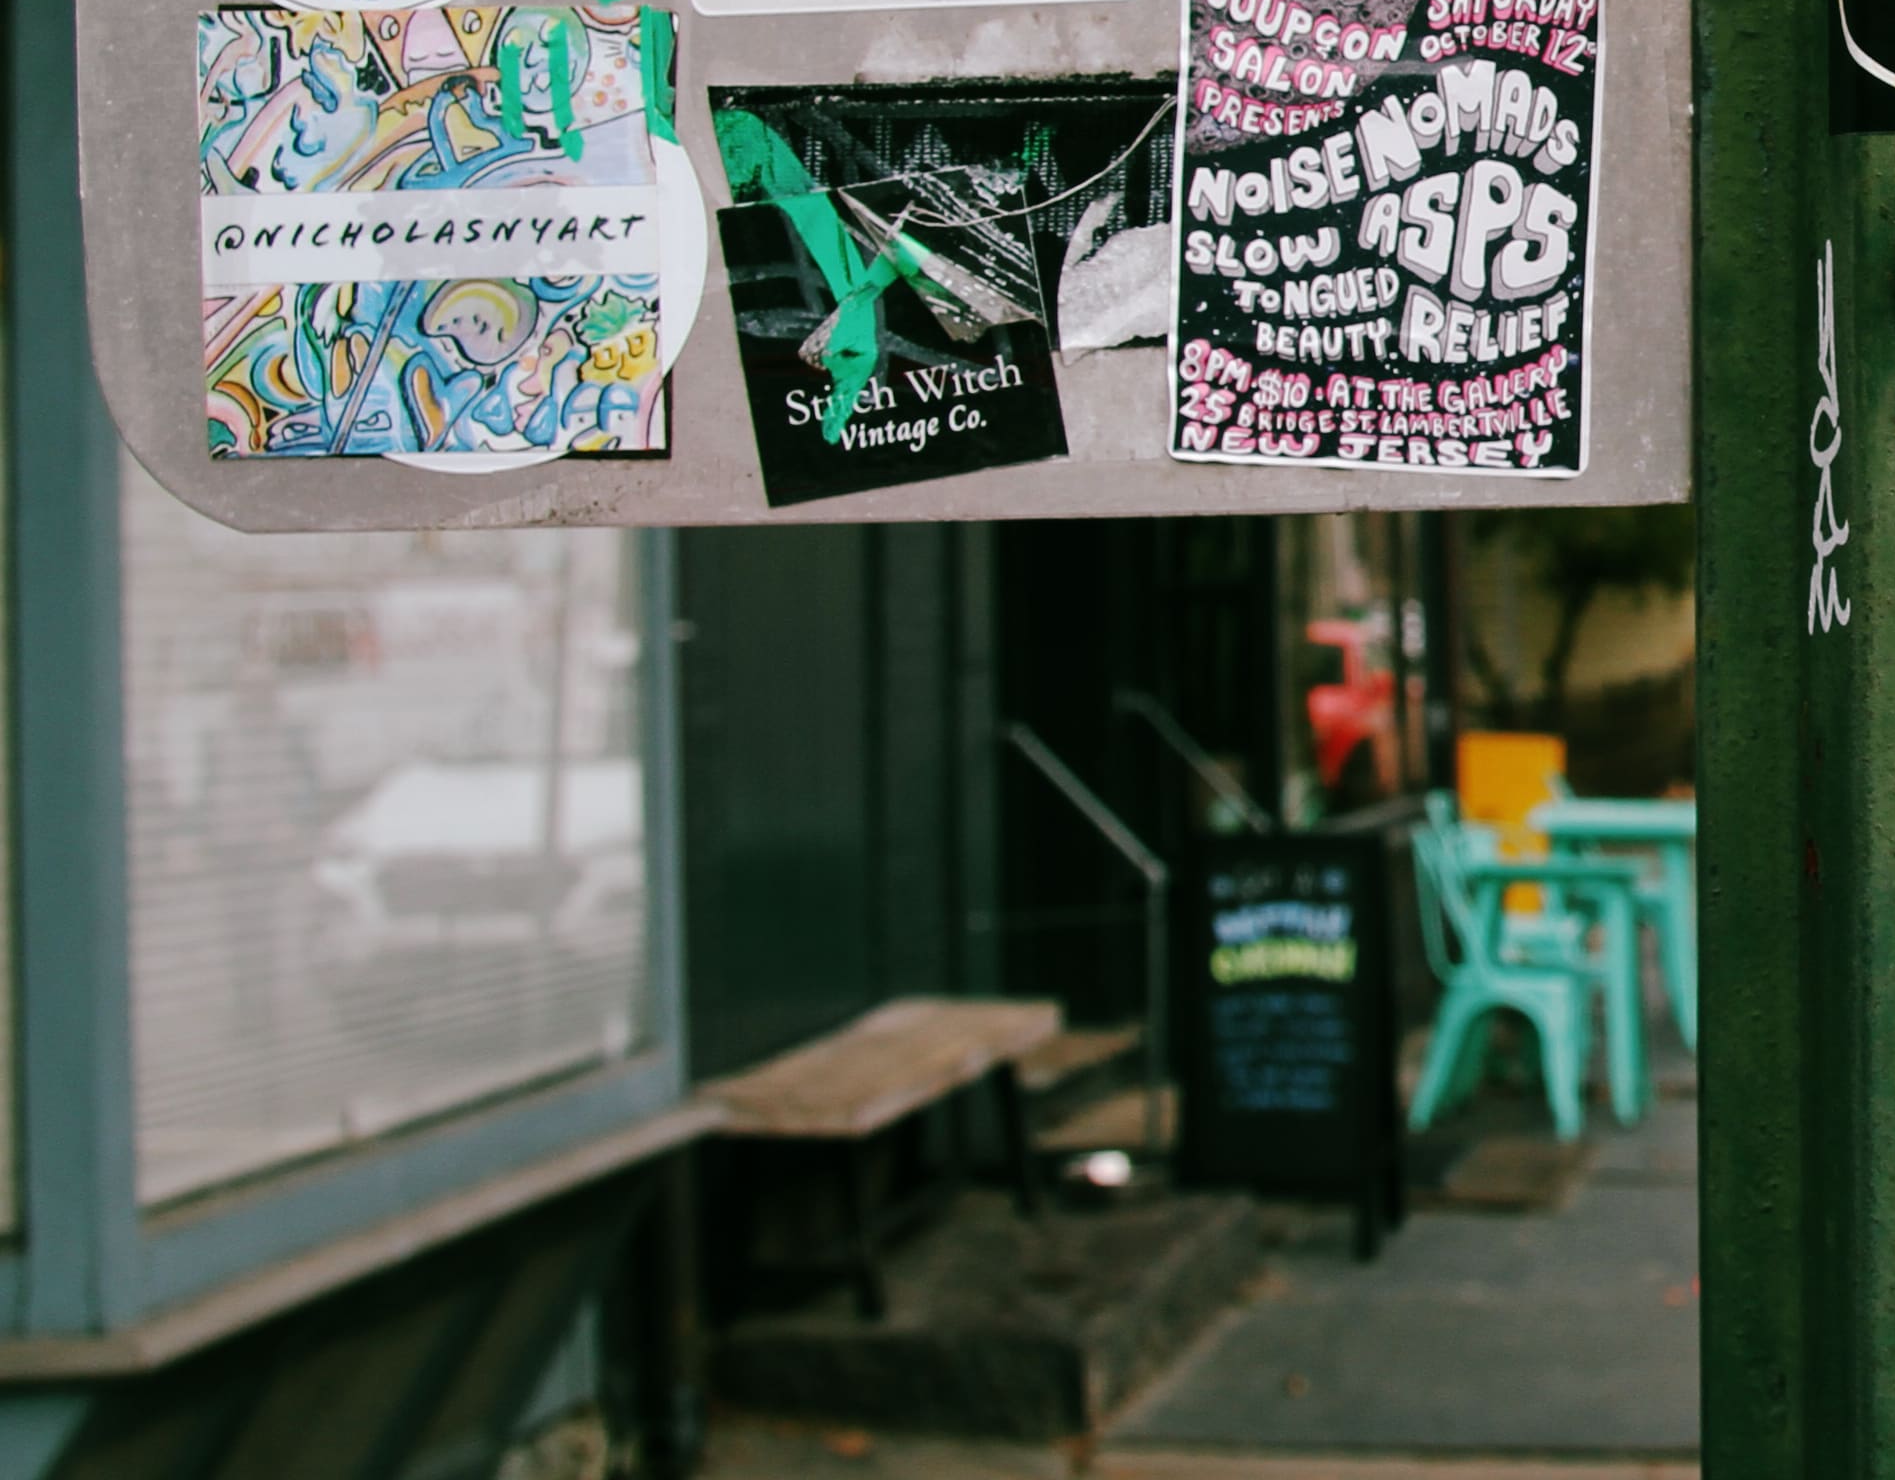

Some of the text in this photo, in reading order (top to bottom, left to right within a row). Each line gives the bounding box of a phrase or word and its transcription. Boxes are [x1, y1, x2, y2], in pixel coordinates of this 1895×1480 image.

[1210, 26, 1356, 97] SALON
[1420, 21, 1540, 63] OCTOBER
[1198, 80, 1345, 136] PRESENTS
[1188, 60, 1579, 223] NOISE NOMADS
[213, 215, 645, 256] @NICHOLASNYART
[1186, 227, 1342, 277] SLOW
[1360, 160, 1578, 302] ASPS
[1233, 267, 1400, 320] TONGUED
[1256, 316, 1393, 365] BEAUTY
[1401, 284, 1569, 365] RELIEF
[905, 354, 1024, 405] Witch
[1179, 339, 1568, 416] 8PM $10 AT THE GALLERY
[840, 404, 987, 452] Vintage Co.
[1179, 382, 1237, 425] 25
[1238, 402, 1335, 433] BRIDGE
[1378, 387, 1572, 439] LAMBERTVILLE
[1181, 421, 1553, 469] NEW JERSEY
